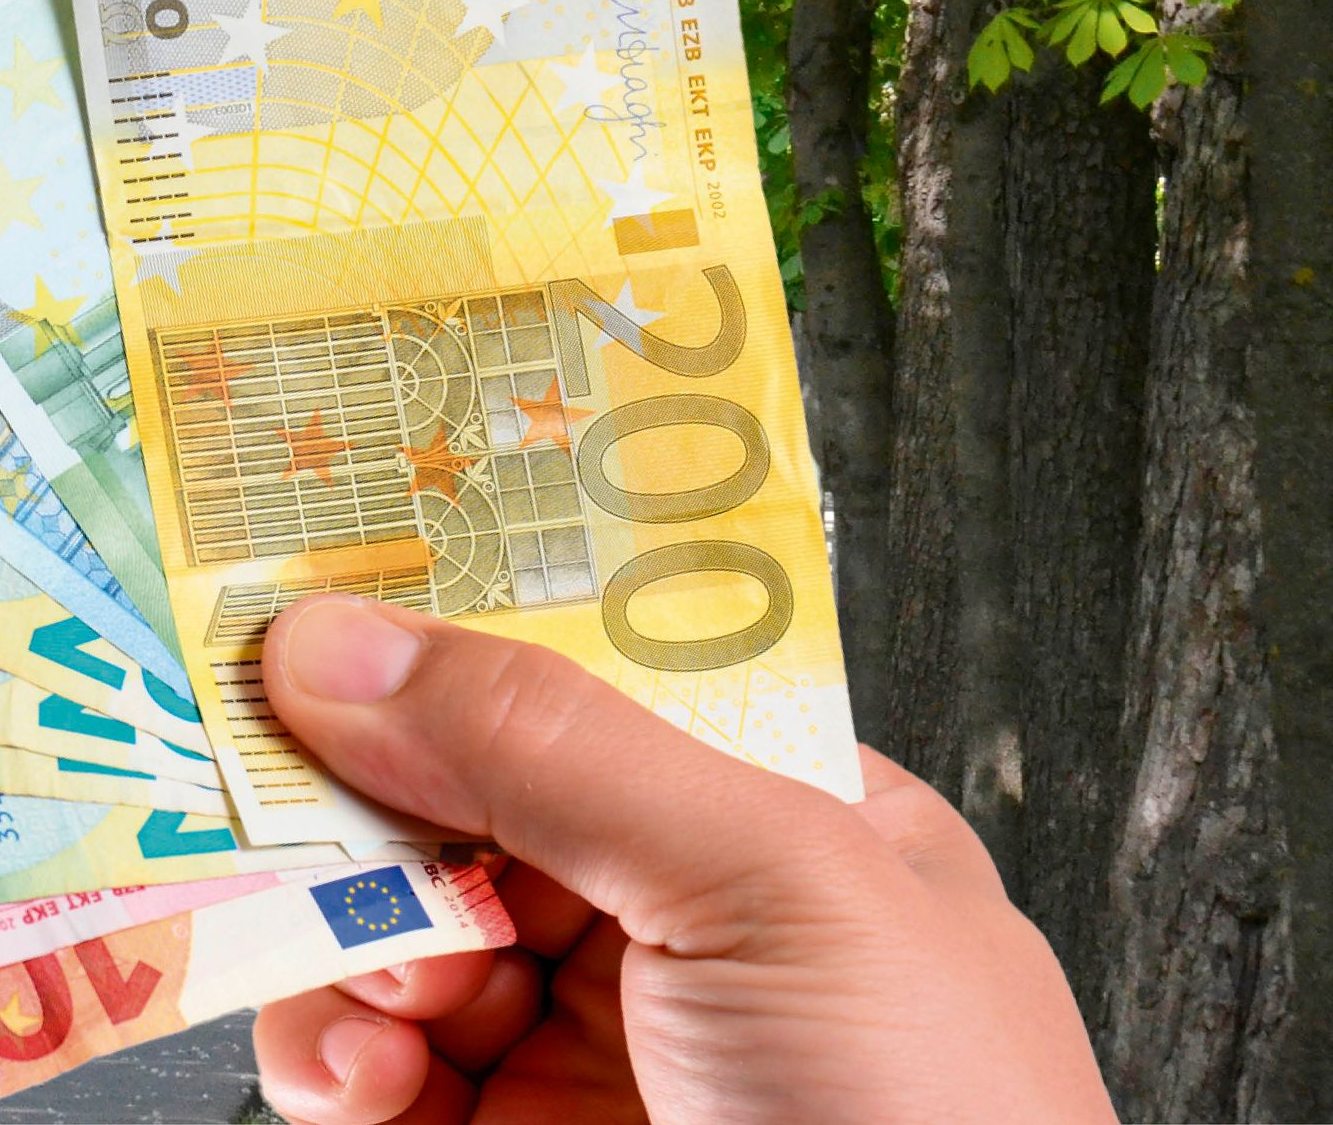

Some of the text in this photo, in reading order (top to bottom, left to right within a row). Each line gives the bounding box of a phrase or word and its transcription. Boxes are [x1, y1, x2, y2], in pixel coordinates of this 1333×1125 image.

[680, 18, 702, 62] EZB
[688, 74, 710, 117] EKT
[694, 127, 716, 172] EKP
[707, 182, 726, 220] 2002
[548, 264, 794, 672] 200
[22, 900, 60, 925] EKP
